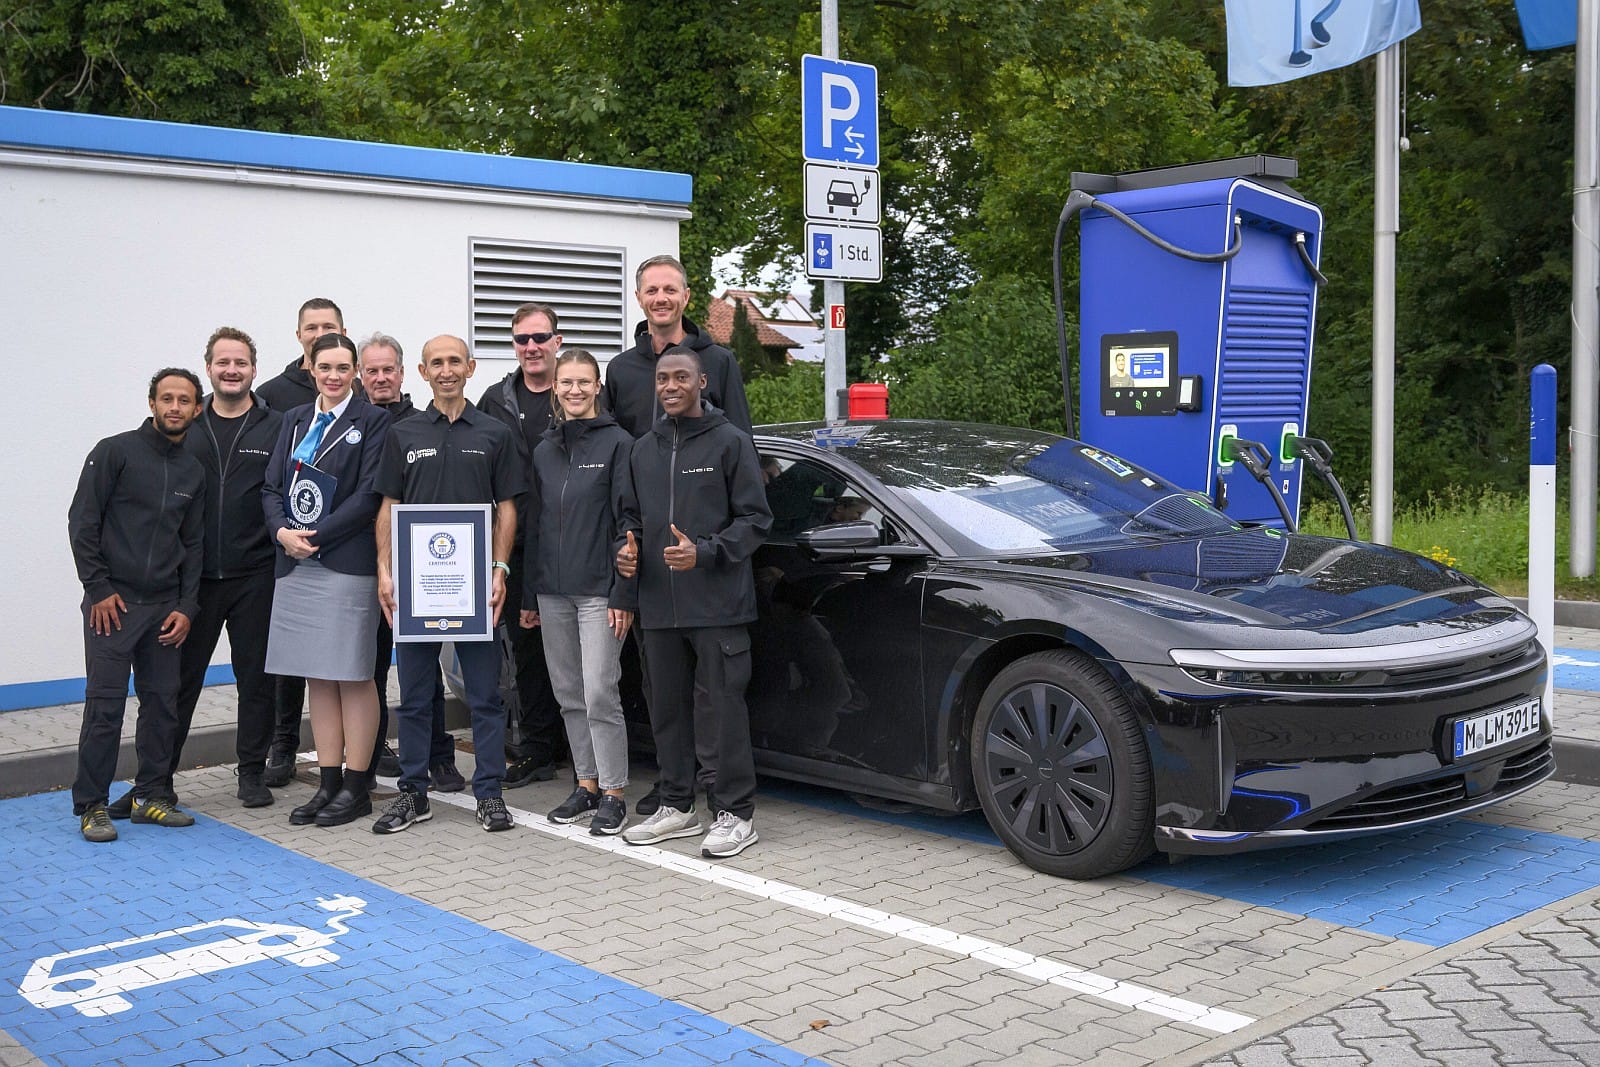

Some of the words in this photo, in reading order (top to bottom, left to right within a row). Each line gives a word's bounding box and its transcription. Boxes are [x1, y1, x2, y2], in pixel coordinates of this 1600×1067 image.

[822, 72, 860, 148] P
[820, 257, 826, 265] P
[839, 244, 844, 260] 1
[847, 244, 872, 262] Std.
[1435, 628, 1505, 649] LUCID
